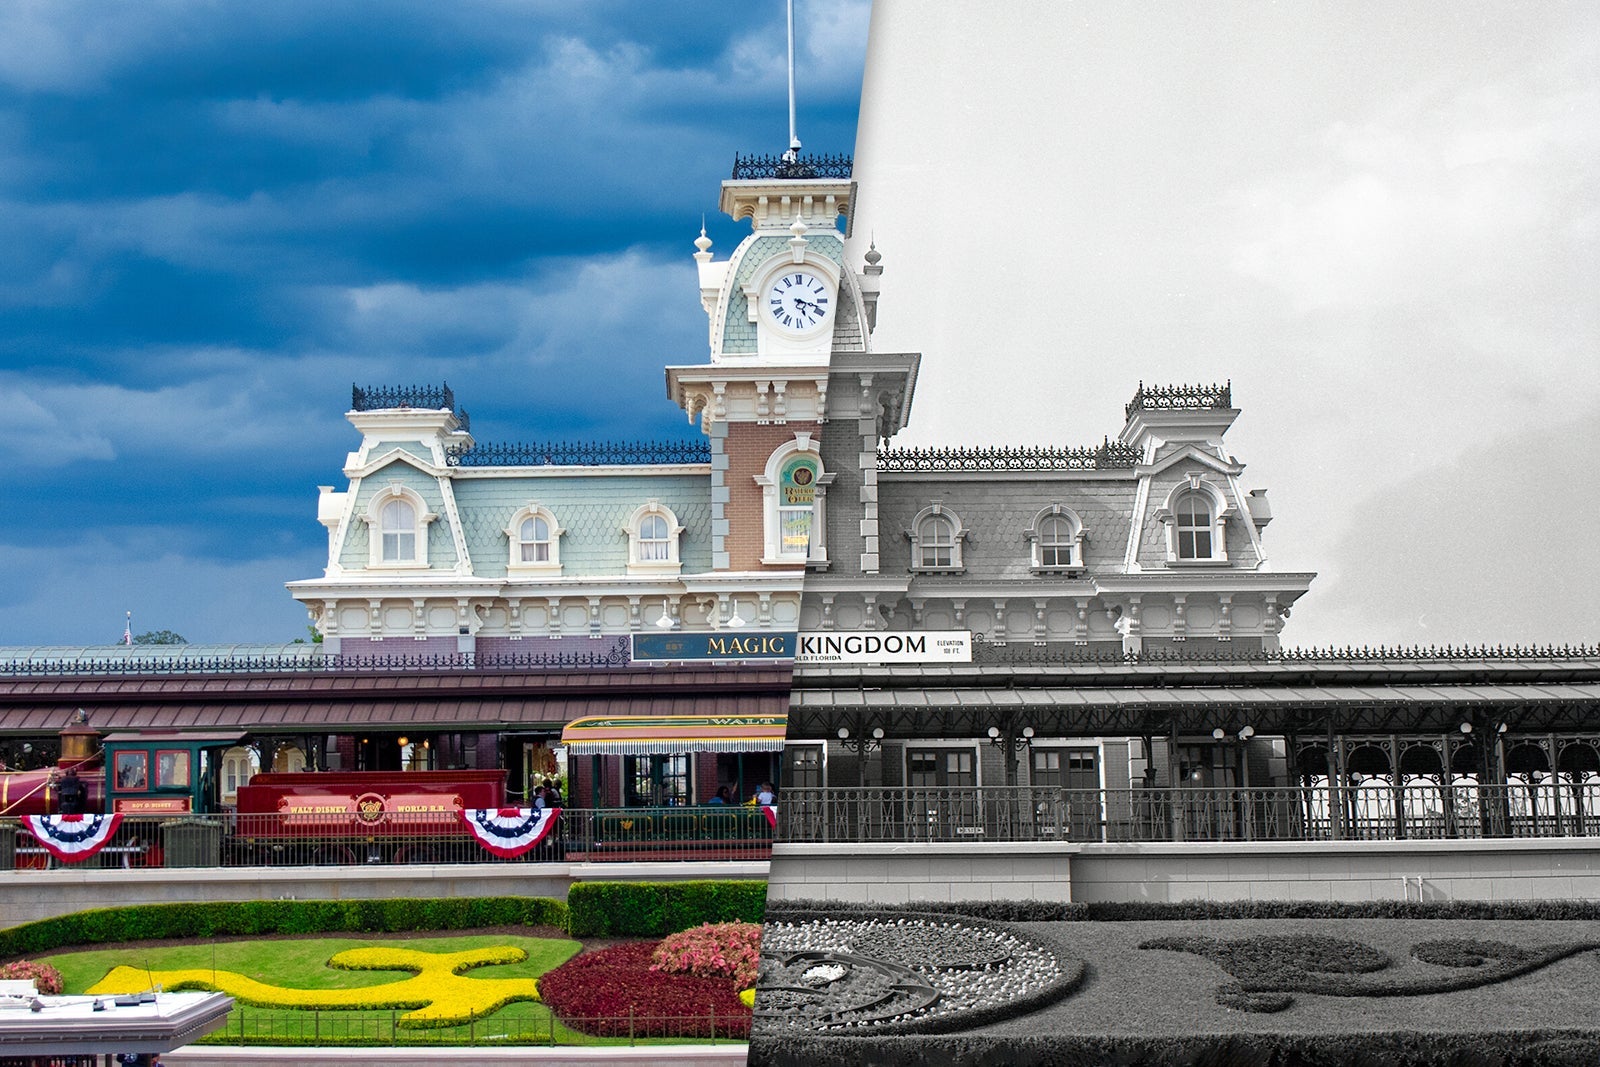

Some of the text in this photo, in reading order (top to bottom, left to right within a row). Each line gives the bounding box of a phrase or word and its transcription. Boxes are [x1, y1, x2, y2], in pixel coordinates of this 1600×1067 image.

[707, 636, 785, 655] MAGIC
[801, 635, 926, 654] KINGDOM
[290, 806, 347, 814] WALT DISNEY
